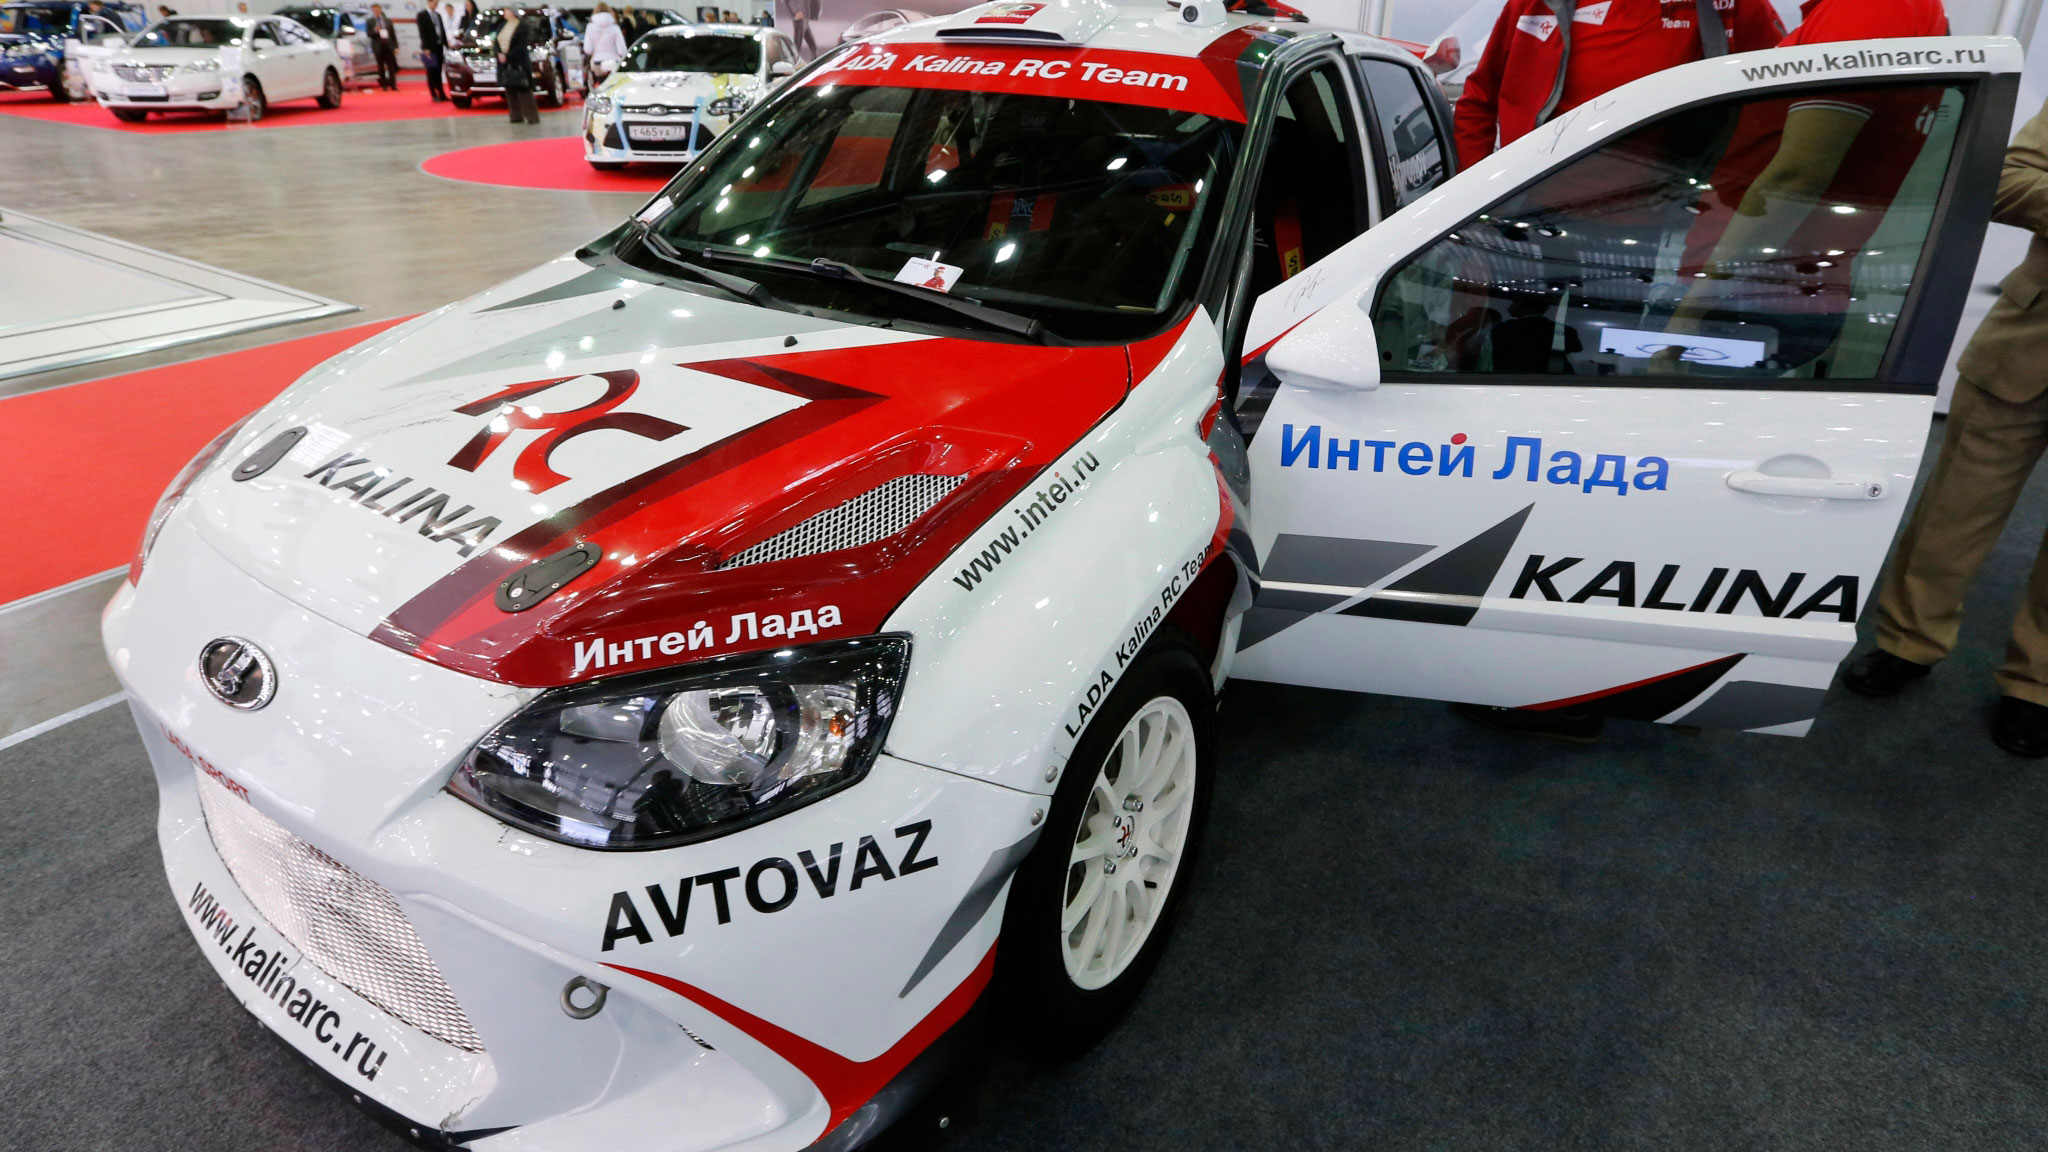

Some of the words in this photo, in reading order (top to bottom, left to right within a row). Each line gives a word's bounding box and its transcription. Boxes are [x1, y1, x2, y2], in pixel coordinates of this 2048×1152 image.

[1661, 18, 1690, 29] Team
[902, 54, 1004, 76] Kalina
[1009, 59, 1071, 79] RC
[1080, 62, 1188, 91] Team
[1741, 49, 1985, 82] www.kalinarc.ru
[1280, 424, 1475, 478] Интей
[1492, 436, 1671, 496] Лада
[303, 451, 502, 559] KALINA
[952, 450, 1100, 592] www.intei.ru
[1508, 554, 1859, 623] KALINA
[574, 620, 714, 673] Интей
[725, 604, 842, 644] Лада
[1065, 669, 1114, 739] LADA
[1115, 605, 1161, 669] Kalina
[1161, 575, 1182, 609] RC
[1181, 542, 1214, 582] Team
[160, 722, 198, 766] LADA
[198, 755, 251, 805] SPORT
[601, 818, 939, 952] AVTOVAZ
[188, 881, 388, 1082] www.kalinarc.ru
